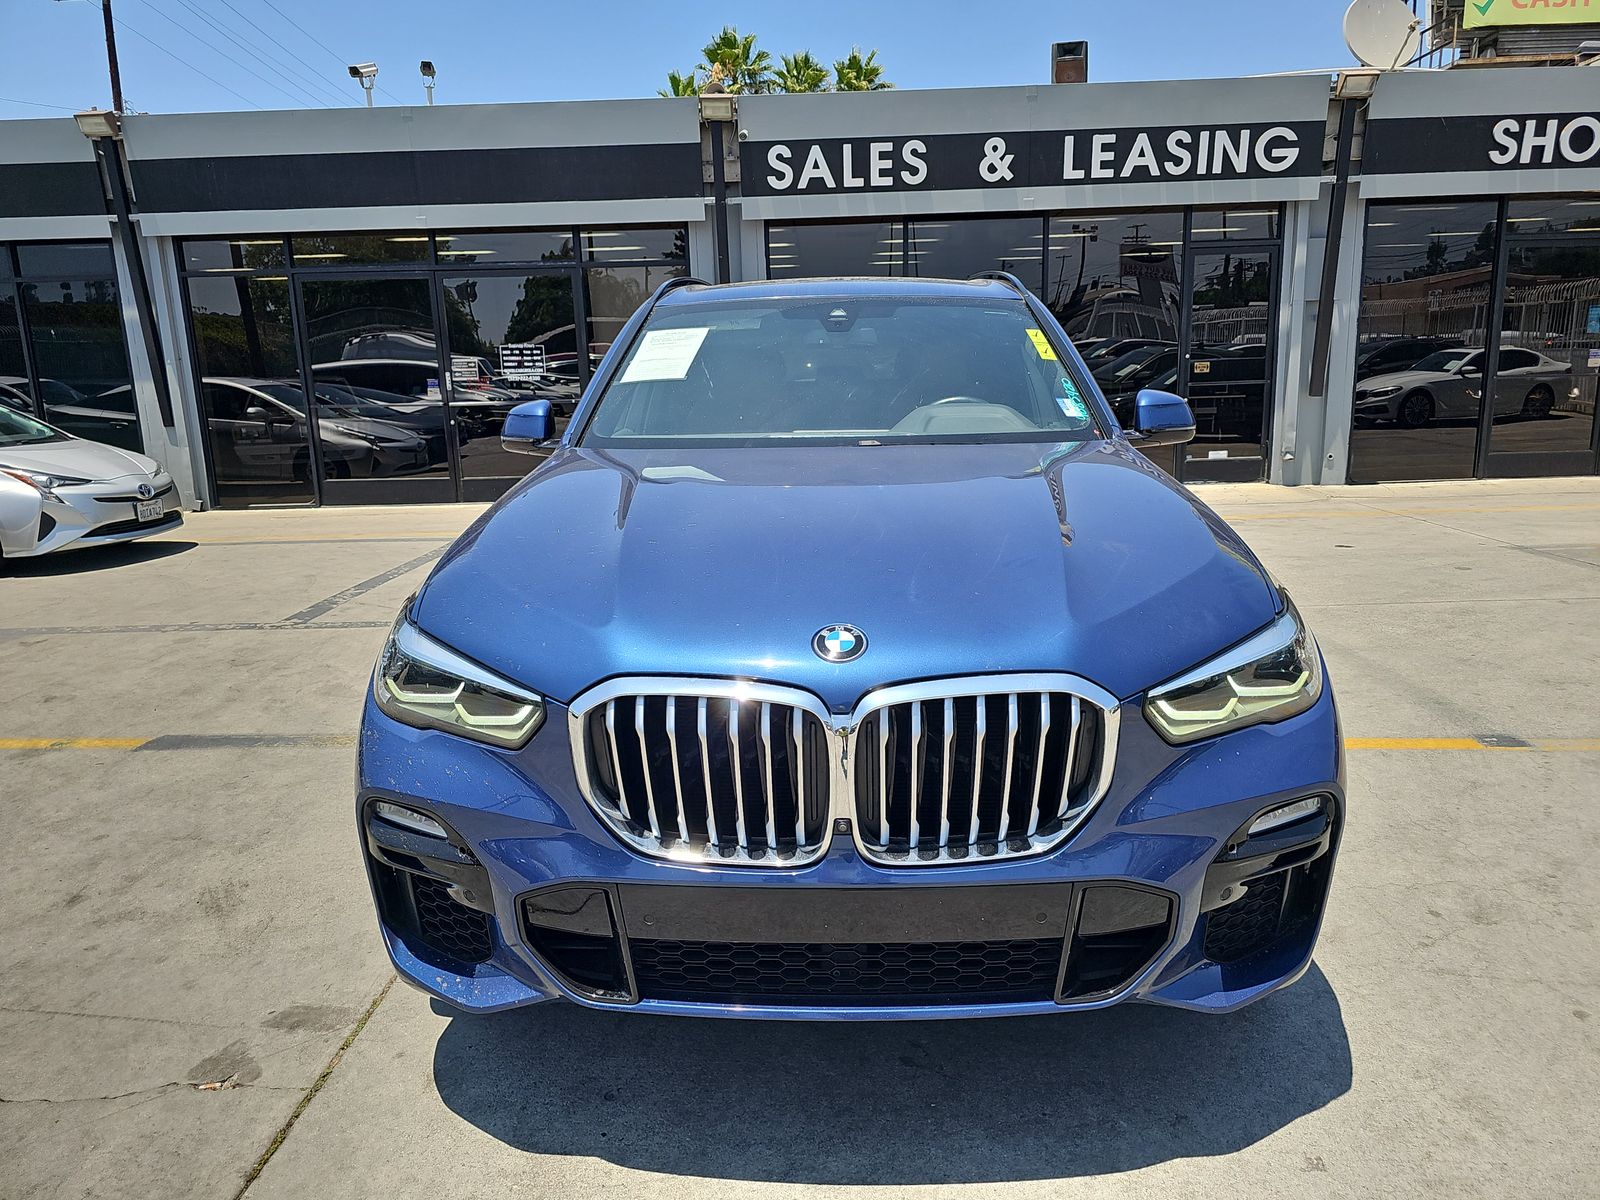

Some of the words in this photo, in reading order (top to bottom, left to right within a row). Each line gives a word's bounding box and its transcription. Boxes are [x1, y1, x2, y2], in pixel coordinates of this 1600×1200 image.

[766, 139, 928, 190] SALES
[978, 136, 1015, 183] &
[1063, 126, 1300, 180] LEASING
[1488, 116, 1600, 165] SHO
